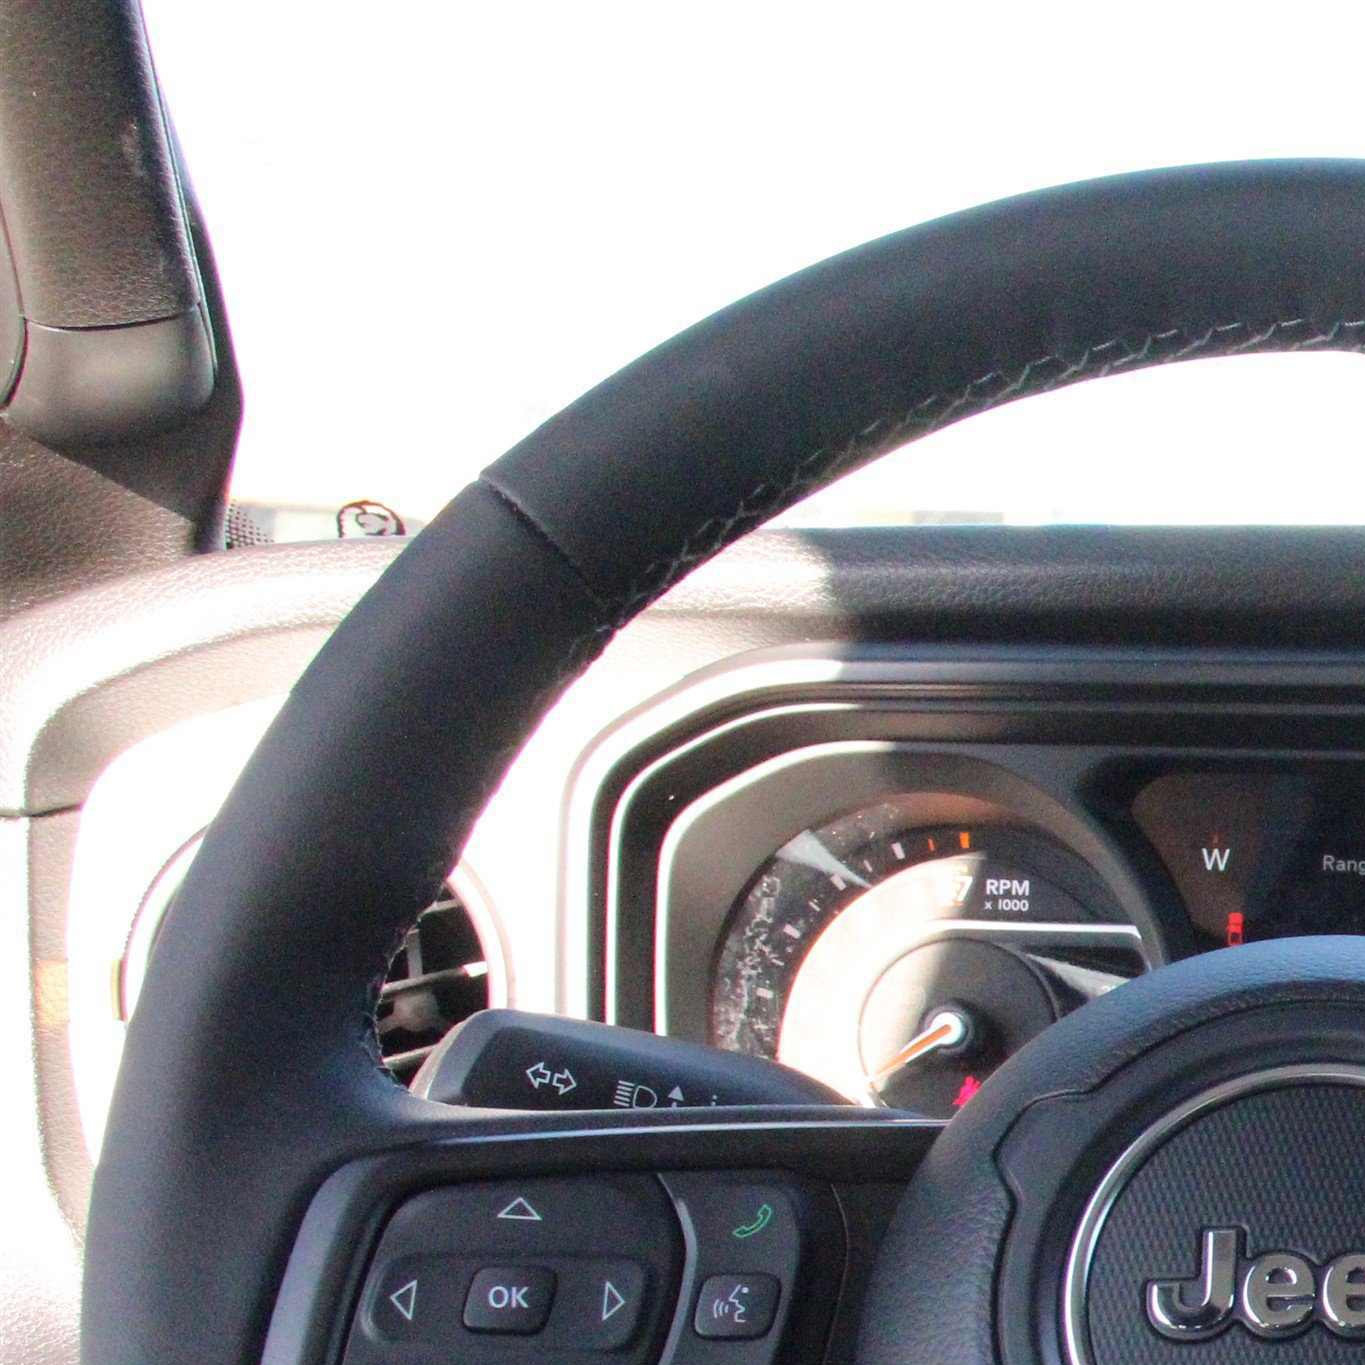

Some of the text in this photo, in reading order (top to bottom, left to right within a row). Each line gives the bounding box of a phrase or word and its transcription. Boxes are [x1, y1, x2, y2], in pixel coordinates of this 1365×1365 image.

[1202, 849, 1231, 871] W
[986, 879, 1030, 896] RPM
[998, 899, 1029, 911] 1000
[488, 1286, 529, 1309] OK
